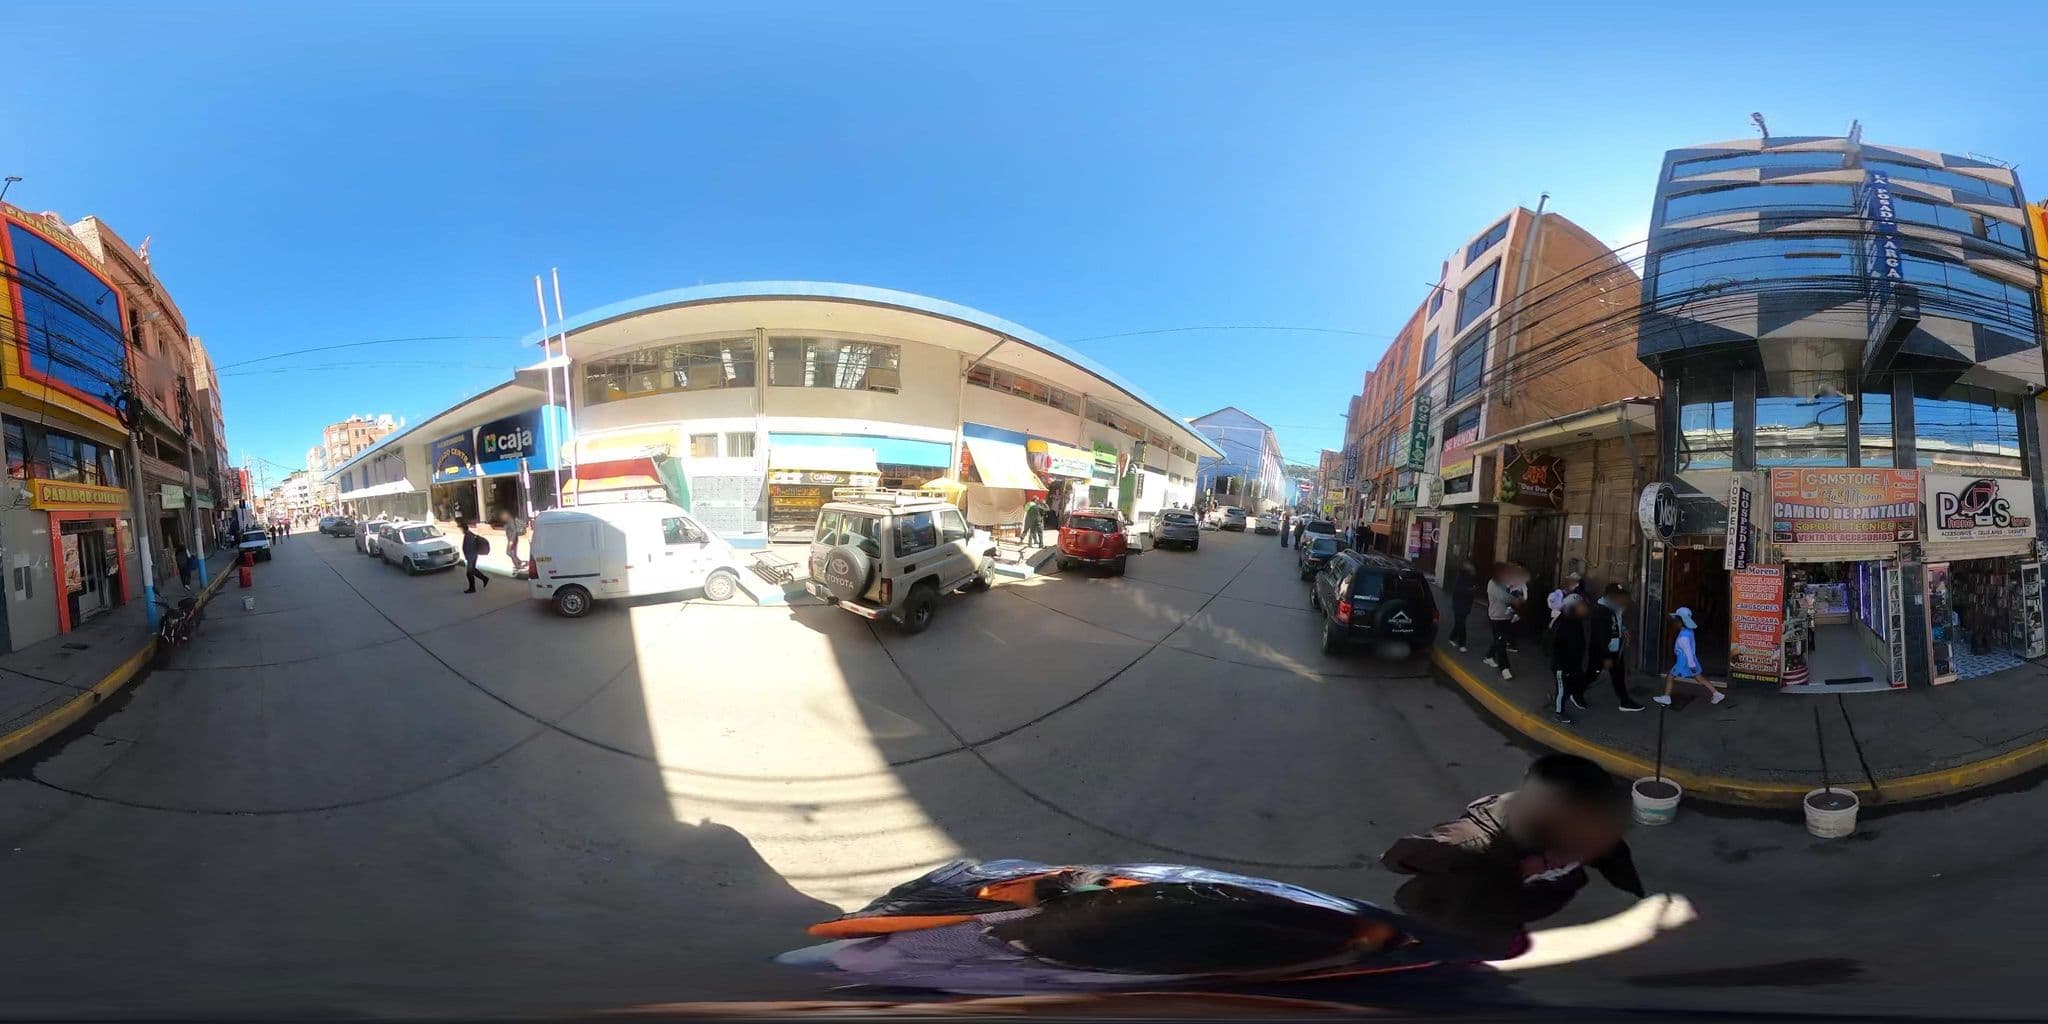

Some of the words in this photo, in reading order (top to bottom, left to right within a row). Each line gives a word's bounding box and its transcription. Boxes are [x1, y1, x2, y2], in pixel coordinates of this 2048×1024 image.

[1414, 396, 1431, 450] HOSTAL
[498, 427, 532, 450] caja
[43, 486, 91, 503] PARADOR
[1774, 502, 1829, 519] CAMBIO
[1834, 507, 1850, 519] DE
[1853, 502, 1916, 519] PANTALLA
[1728, 477, 1739, 567] HOSPEDAJE
[1737, 491, 1749, 568] HOSPEDAJE
[1748, 567, 1779, 575] Morena
[828, 575, 854, 589] TOYOTA
[1736, 603, 1778, 611] CARGADORES
